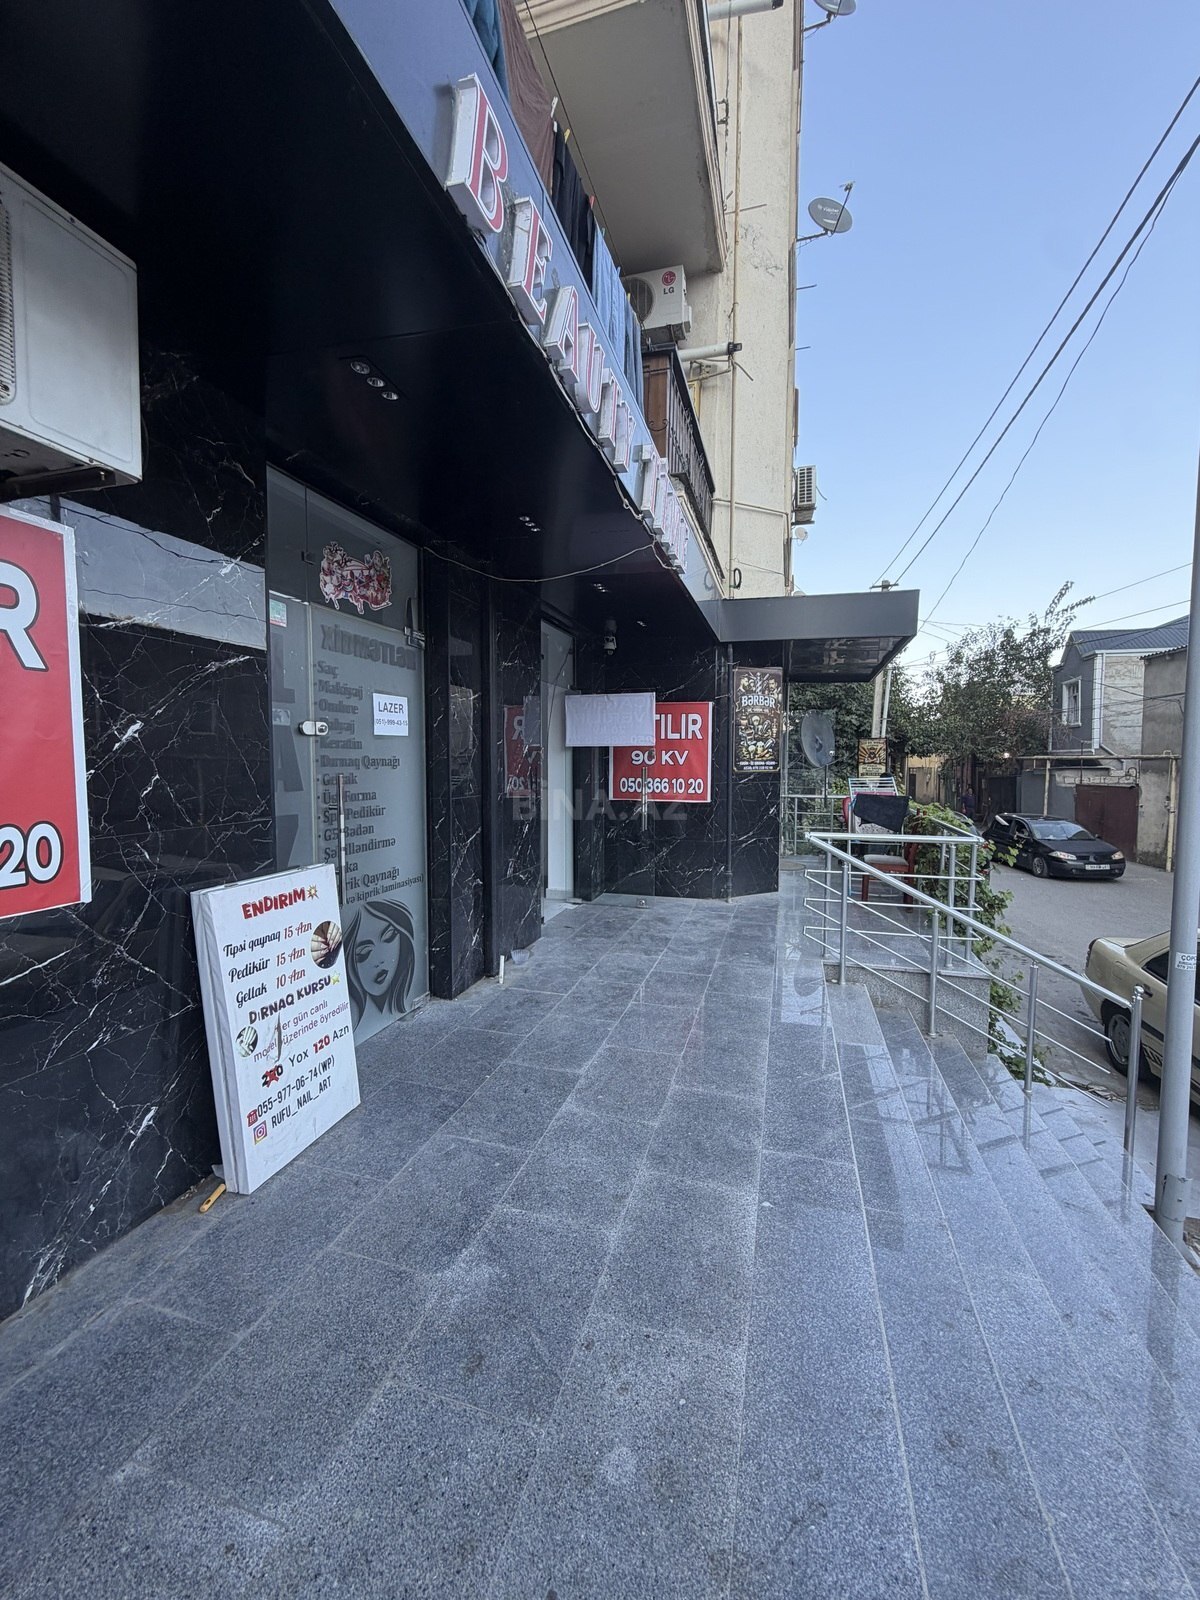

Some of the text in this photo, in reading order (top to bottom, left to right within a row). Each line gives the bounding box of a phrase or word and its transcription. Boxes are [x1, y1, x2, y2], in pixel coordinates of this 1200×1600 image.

[444, 72, 636, 473] BEAUTY
[663, 287, 675, 295] LG
[378, 701, 404, 714] LAZER
[363, 755, 401, 770] Qaynağı
[661, 750, 689, 765] KV
[672, 778, 685, 794] 10
[687, 778, 704, 794] 20
[347, 805, 387, 820] Pedikür
[363, 866, 400, 887] Qaynağı
[242, 887, 306, 919] ENDIRIM
[248, 931, 281, 952] qaynaq
[284, 925, 293, 940] 15
[295, 922, 312, 936] Azn
[228, 948, 305, 983] Pedikür 15 Azn
[236, 968, 305, 1009] Gellak 10 Azn
[296, 975, 331, 1000] KURSU
[282, 1021, 318, 1046] üzerinde
[320, 1001, 349, 1024] öyredilir
[293, 1010, 308, 1027] gün
[310, 999, 328, 1017] canlı
[288, 1049, 309, 1067] Yox
[312, 1034, 331, 1053] 120
[332, 1025, 349, 1042] Azn
